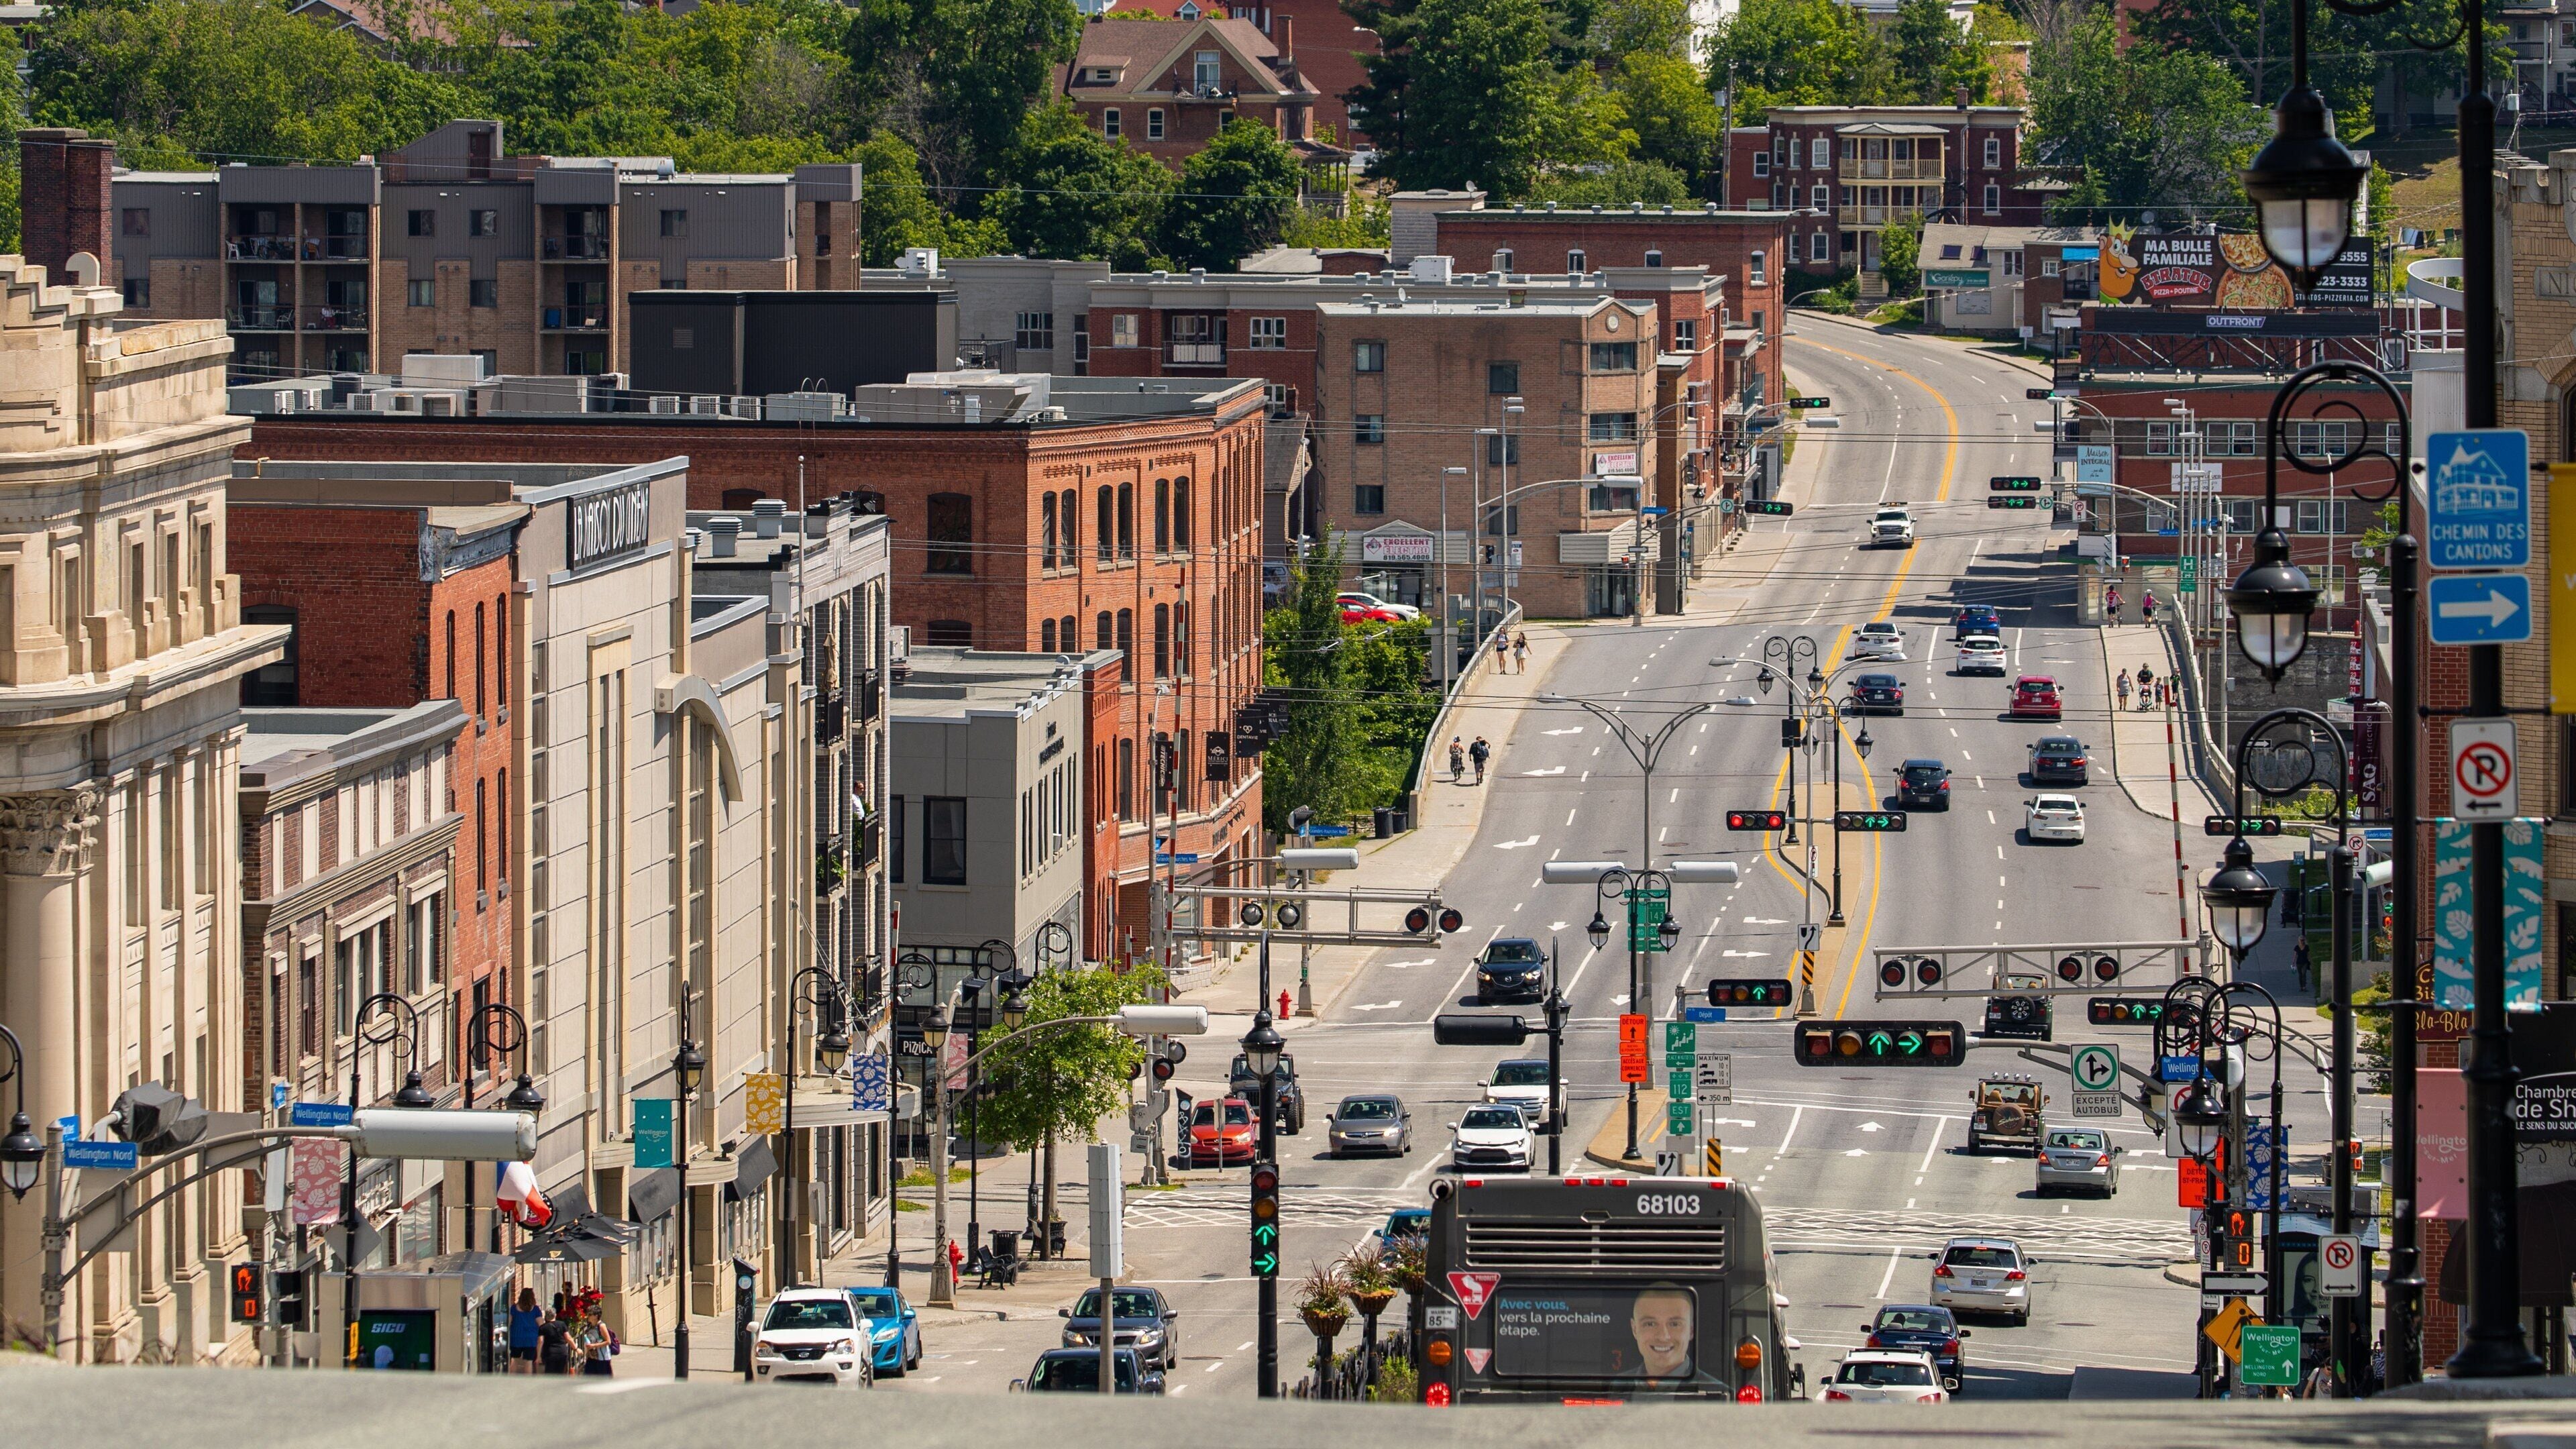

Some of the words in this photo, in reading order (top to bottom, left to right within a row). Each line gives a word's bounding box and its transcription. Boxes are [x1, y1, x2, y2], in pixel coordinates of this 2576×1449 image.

[2145, 240, 2168, 252] MA
[2171, 240, 2211, 252] BULLE
[2143, 254, 2212, 265] FAMILIALE
[2140, 266, 2212, 290] STRATOS
[2174, 286, 2198, 294] POUTINE
[2208, 317, 2262, 326] OUTFRONT
[574, 505, 583, 561] LA
[613, 494, 625, 549] DU
[2432, 524, 2489, 541] CHEMIN
[2496, 523, 2526, 540] DES
[2445, 543, 2513, 561] CANTONS
[2363, 763, 2376, 802] SAQ
[1650, 912, 1664, 920] 143
[2167, 1062, 2199, 1075] Wellingt
[1673, 1083, 1687, 1095] 112
[2076, 1095, 2117, 1104] EXCEPTÉ
[1672, 1106, 1688, 1114] EST
[2516, 1099, 2542, 1118] de
[295, 1109, 331, 1122] Wellington
[333, 1112, 350, 1121] Nord
[2516, 1122, 2524, 1130] LE
[2526, 1122, 2545, 1130] SENS
[2547, 1122, 2558, 1130] DU
[2416, 1134, 2468, 1153] ellingto
[67, 1147, 111, 1162] Wellington
[113, 1150, 133, 1161] Nord
[1637, 1194, 1700, 1214] 68103
[1499, 1299, 1532, 1310] Avec
[1534, 1301, 1569, 1311] vous,
[1428, 1316, 1442, 1326] 85
[1499, 1313, 1527, 1323] vers
[1531, 1311, 1542, 1323] la
[1546, 1311, 1611, 1326] prochaine
[371, 1322, 406, 1333] SICO
[1499, 1324, 1540, 1338] étape.
[2247, 1333, 2296, 1348] Wellington
